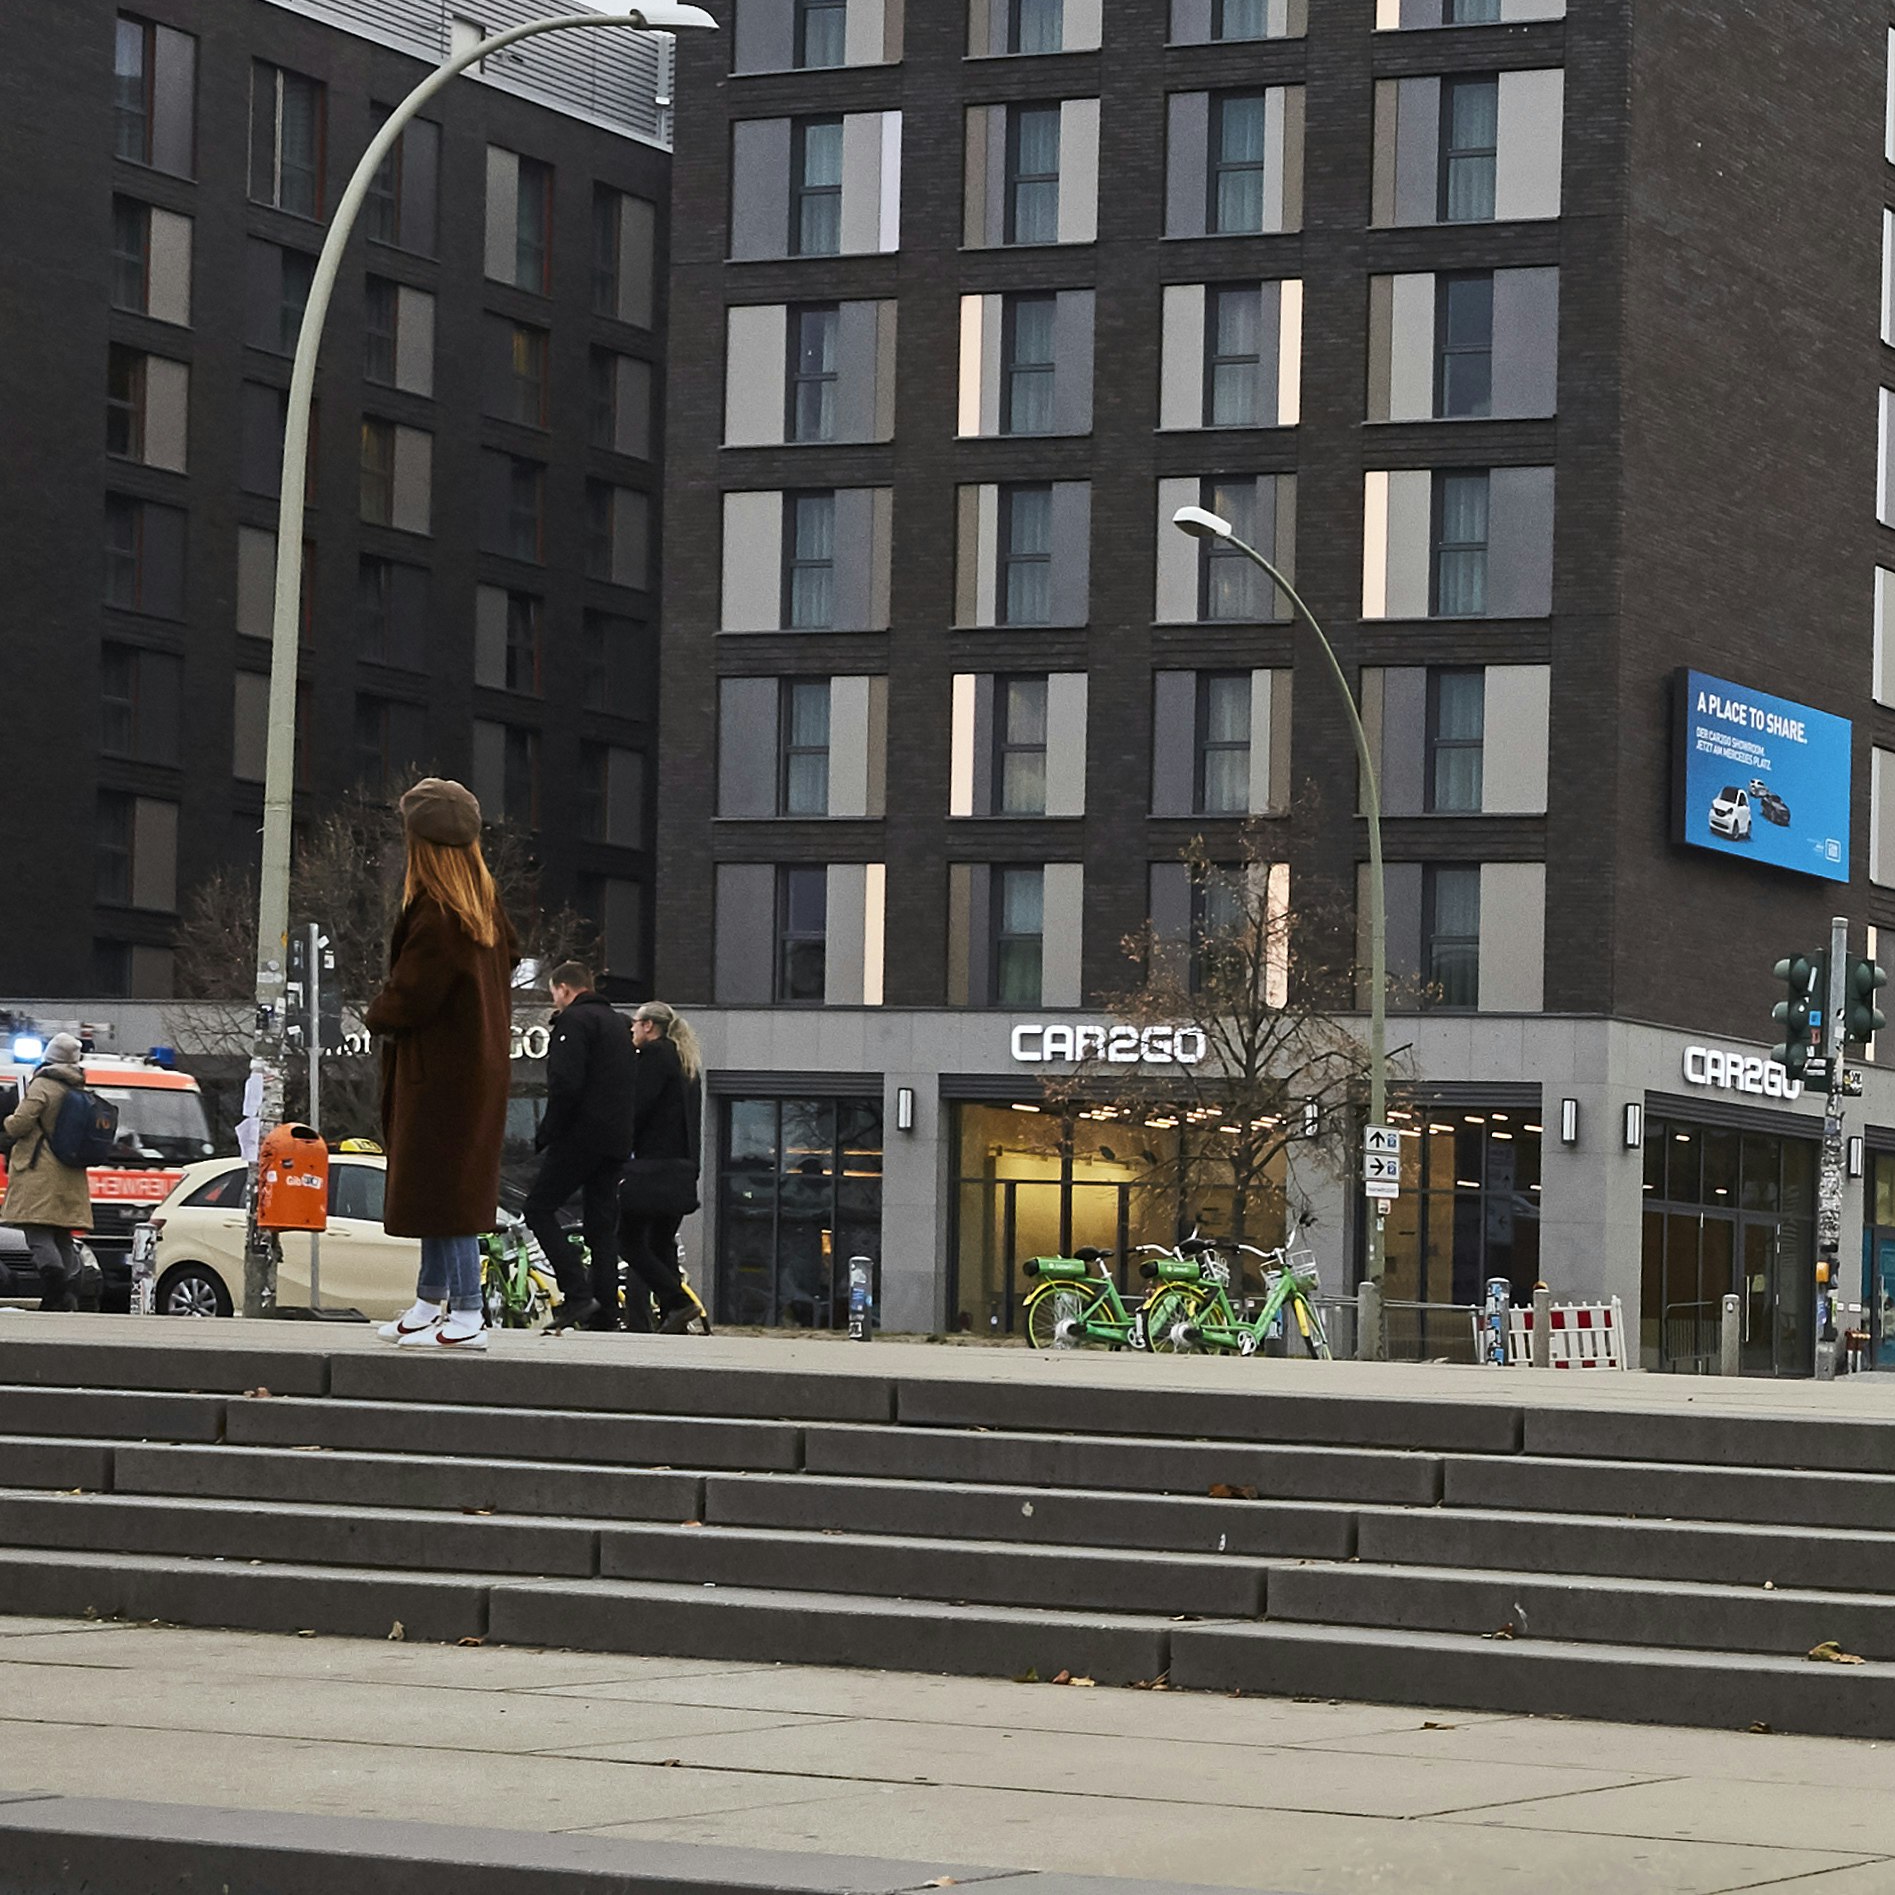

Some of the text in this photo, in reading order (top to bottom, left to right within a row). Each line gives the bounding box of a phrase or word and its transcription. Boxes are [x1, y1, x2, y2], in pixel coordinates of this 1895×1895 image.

[1697, 691, 1808, 744] A PLACE TO SHARE.
[1011, 1024, 1207, 1063] CAR2GO
